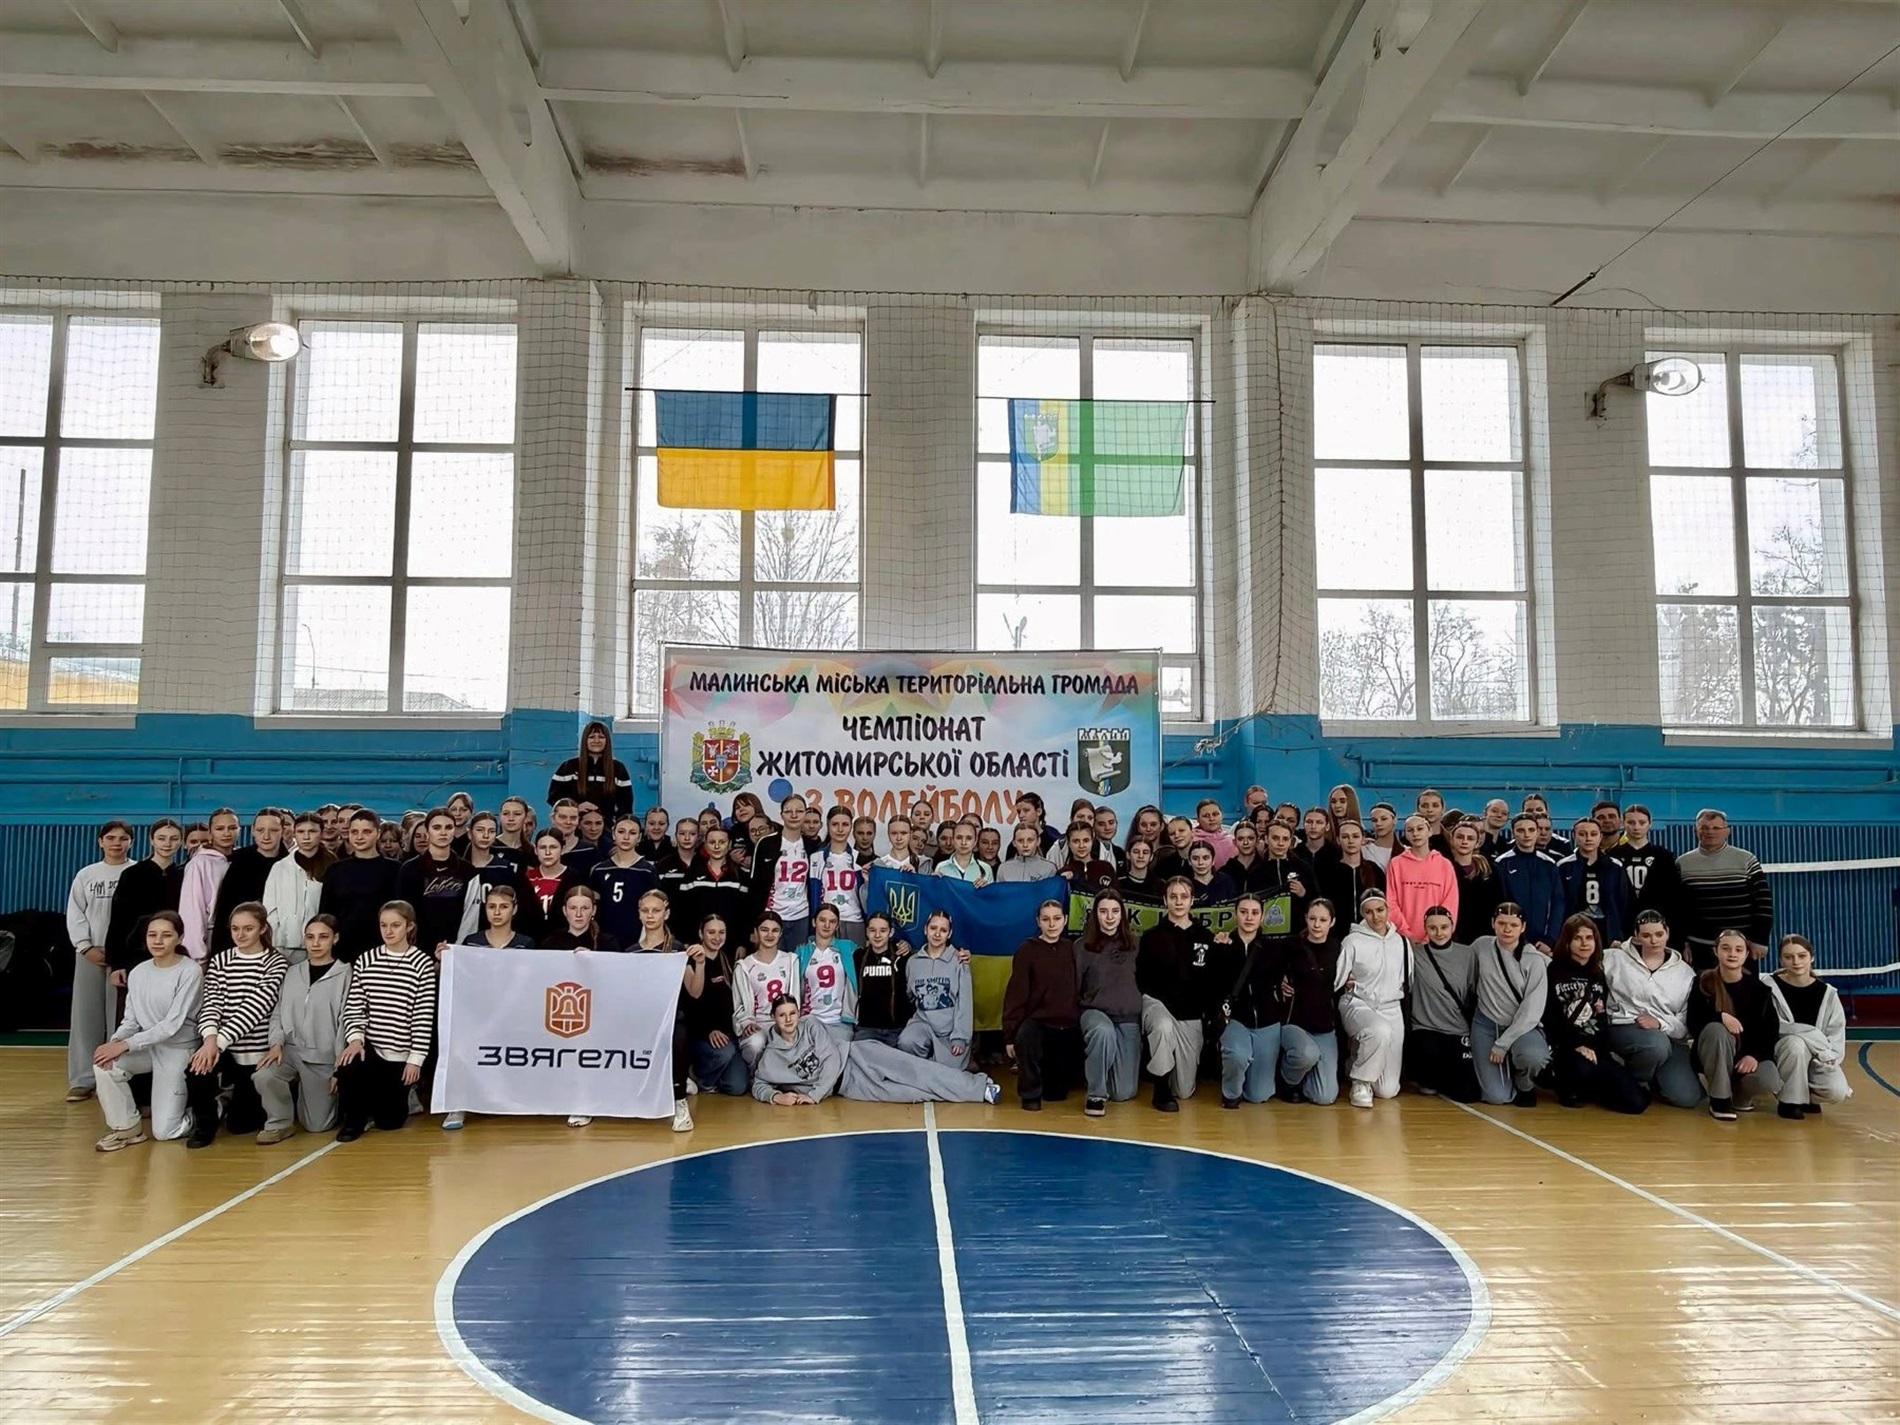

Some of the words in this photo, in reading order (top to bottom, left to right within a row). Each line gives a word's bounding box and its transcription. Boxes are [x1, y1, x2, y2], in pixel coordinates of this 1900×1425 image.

[689, 671, 809, 693] МАЛИНСЬКА
[1052, 674, 1139, 695] ГРОМАДА
[756, 748, 962, 778] ЖИТОМИРСЬКОЇ
[834, 784, 1024, 824] ВОЛЕЙБОЛУ
[778, 861, 808, 882] 12
[827, 870, 856, 891] 10
[1626, 865, 1648, 889] 10
[612, 882, 624, 903] 5
[1586, 880, 1600, 904] 8
[816, 965, 835, 988] 9
[862, 965, 892, 977] PUMA
[766, 979, 783, 1003] 8
